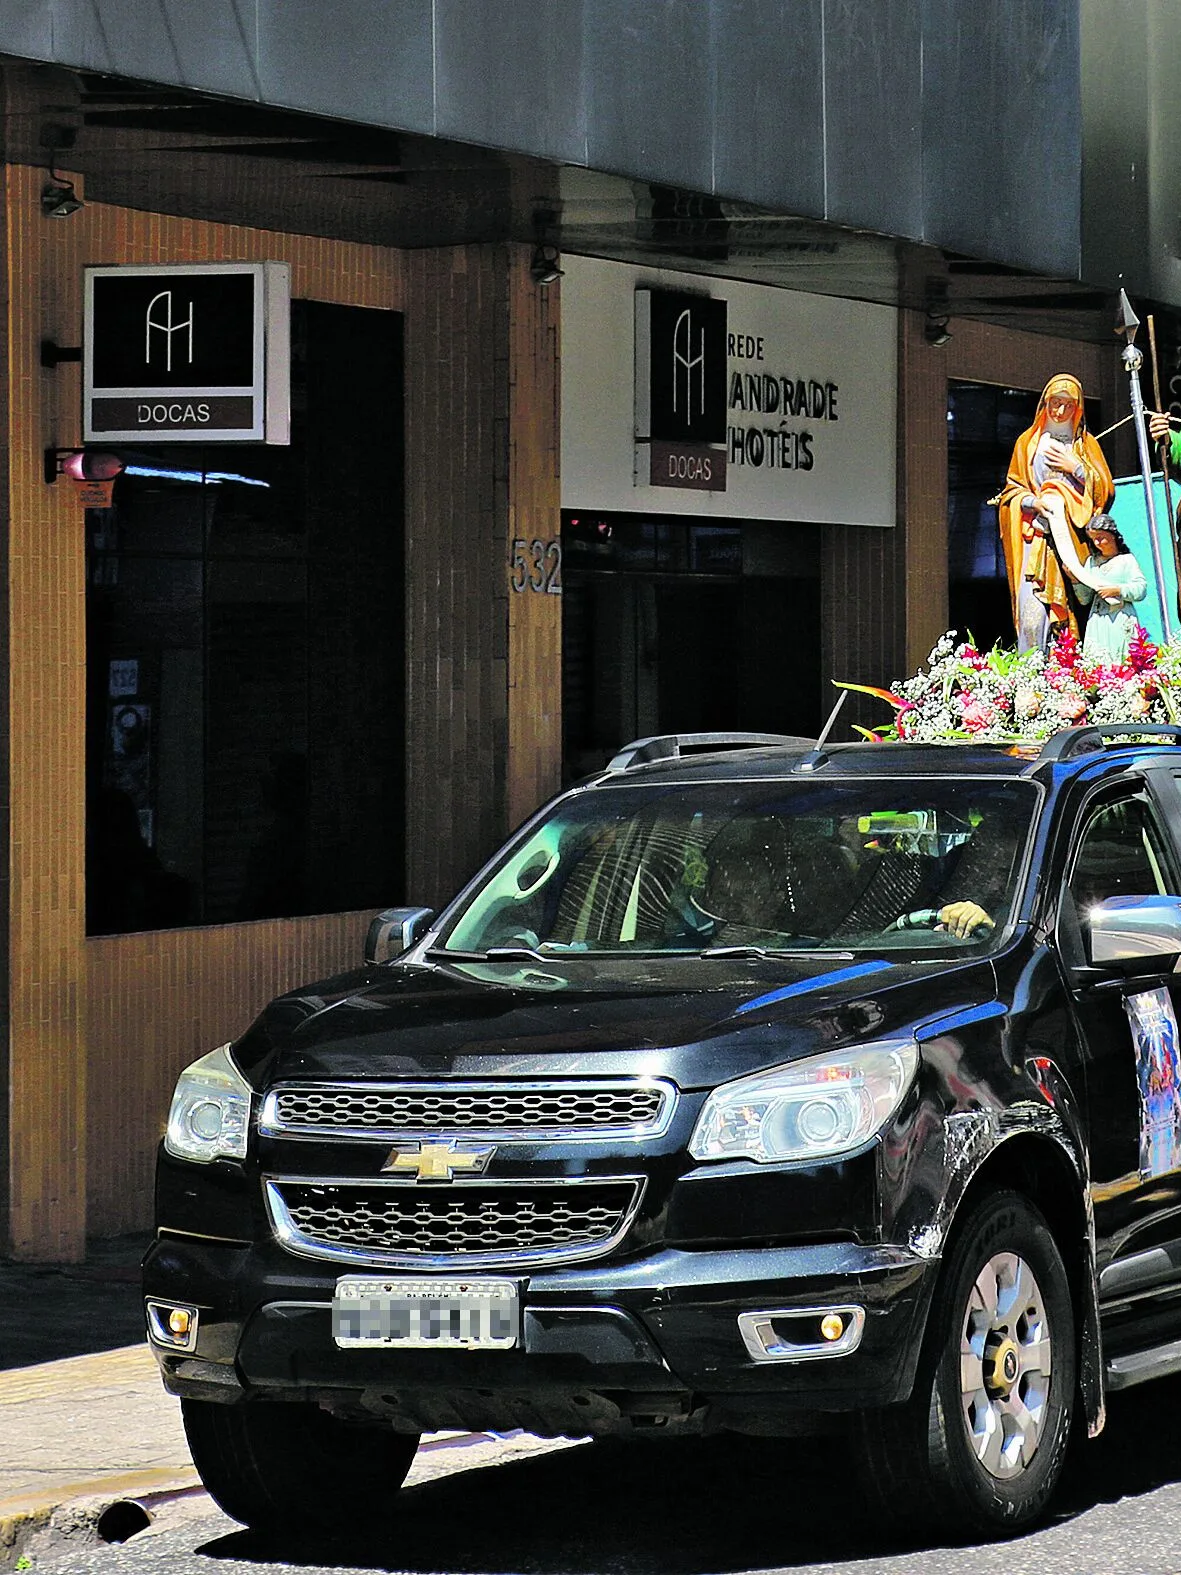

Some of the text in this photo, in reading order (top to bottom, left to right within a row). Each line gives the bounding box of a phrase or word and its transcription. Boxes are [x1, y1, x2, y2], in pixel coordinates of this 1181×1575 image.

[727, 333, 764, 361] REDE
[138, 404, 210, 423] DOCAS
[729, 371, 839, 421] ANDRADE
[728, 420, 814, 472] HOTÉIS
[668, 454, 712, 481] DOCAS
[514, 541, 562, 593] 532
